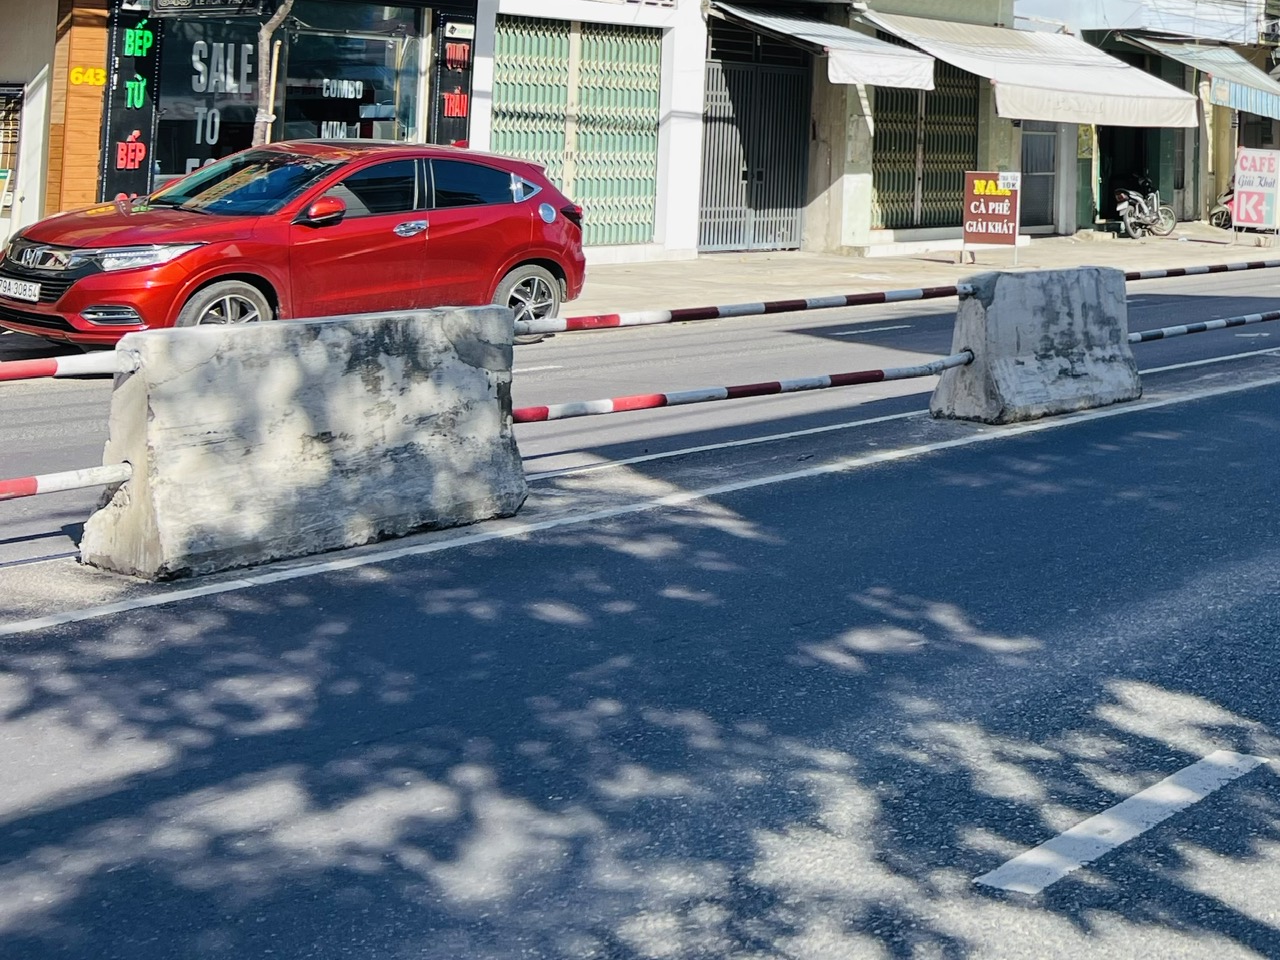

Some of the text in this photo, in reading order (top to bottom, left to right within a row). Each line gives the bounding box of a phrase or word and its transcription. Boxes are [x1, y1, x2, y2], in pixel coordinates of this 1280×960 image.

[123, 19, 153, 57] BẾP
[70, 67, 107, 86] 643
[191, 40, 254, 93] SALE
[322, 78, 363, 99] COMBO
[194, 106, 220, 145] TO
[116, 129, 146, 169] BẾP
[1240, 152, 1276, 173] CAFÉ
[1002, 181, 1017, 189] 10K
[988, 198, 1011, 215] PHÊ
[987, 219, 1015, 234] KHÁT
